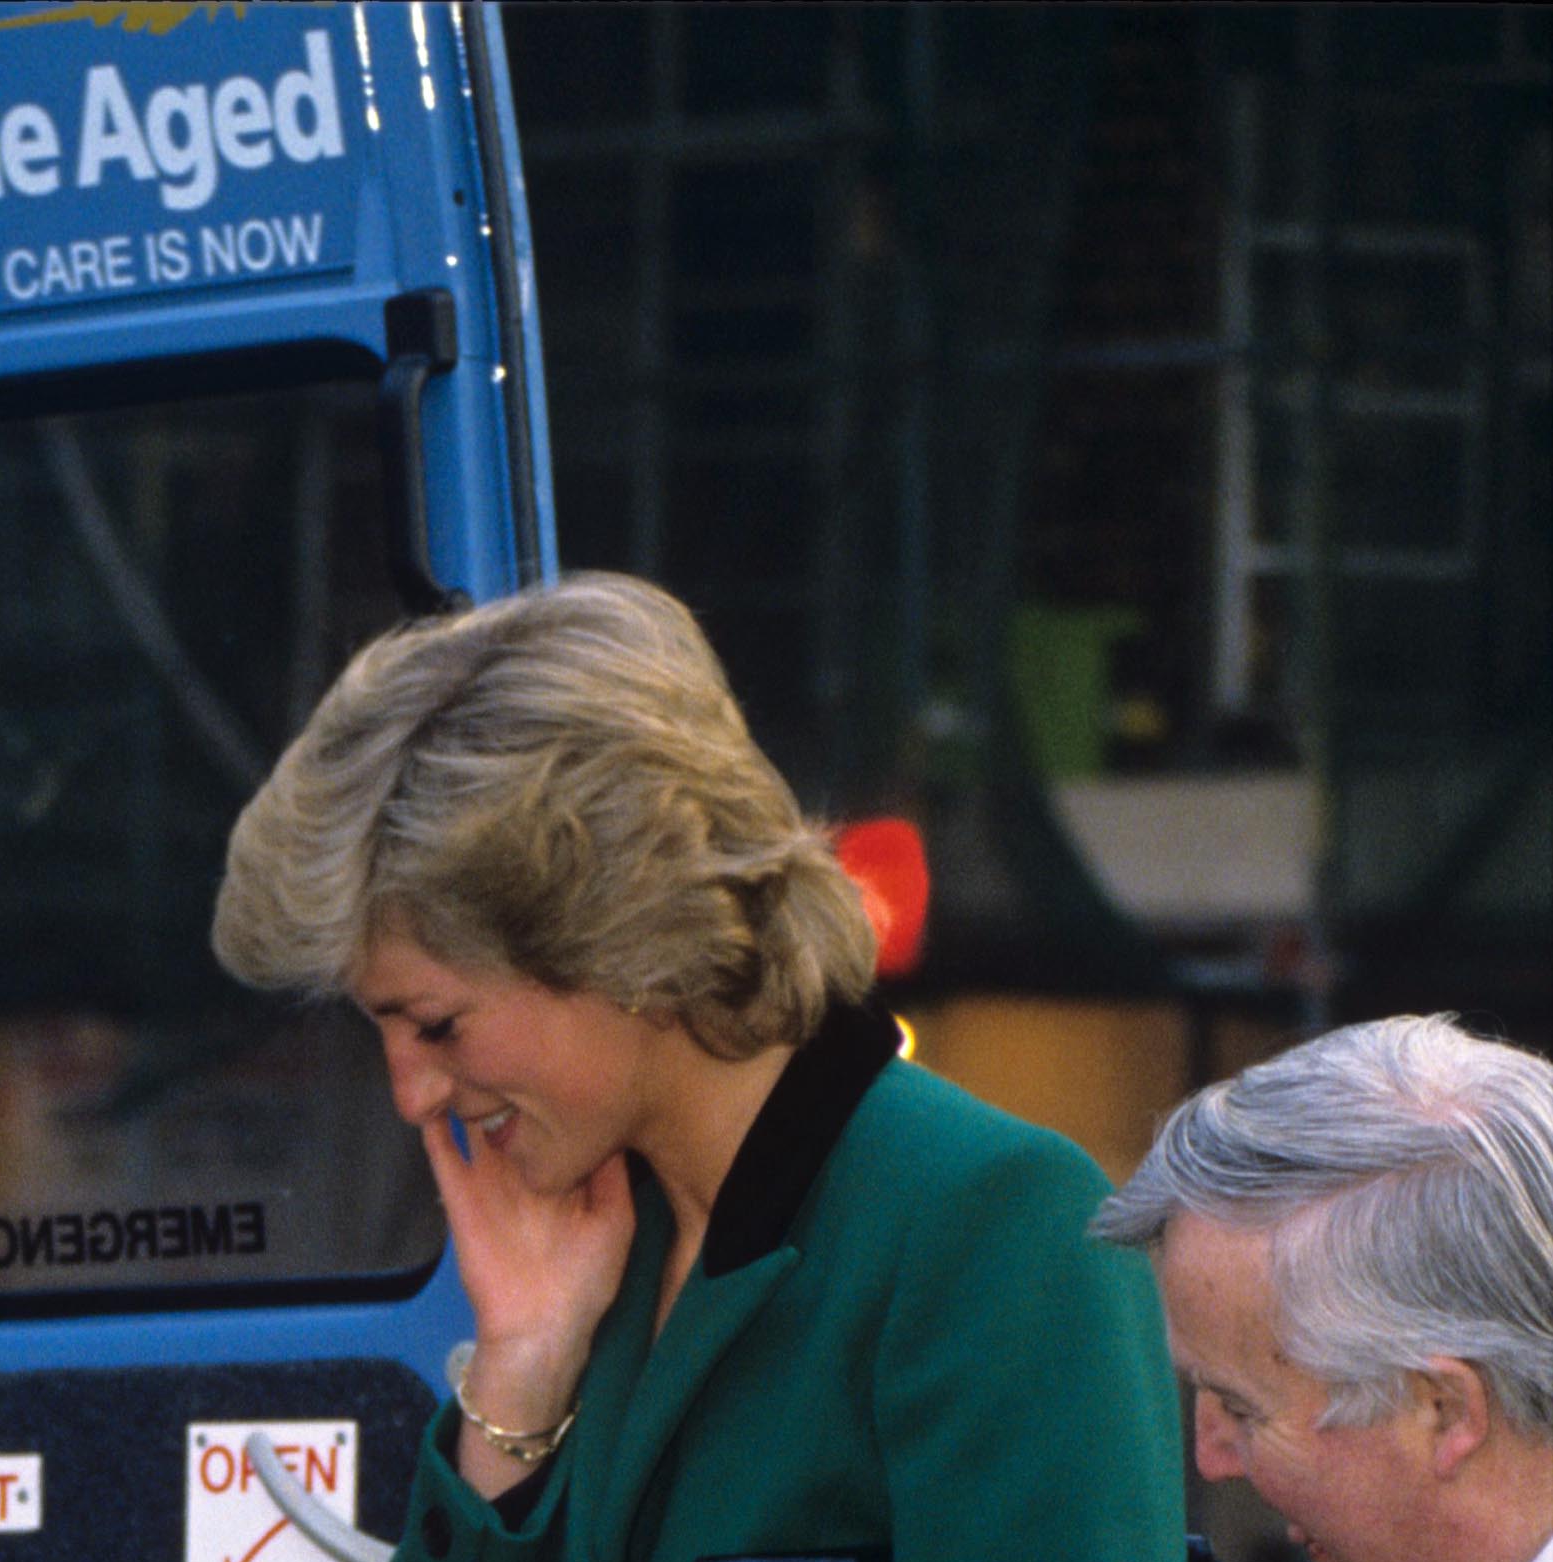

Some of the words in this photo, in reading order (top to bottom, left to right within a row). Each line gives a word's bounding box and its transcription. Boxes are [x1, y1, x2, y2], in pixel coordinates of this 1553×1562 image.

[76, 28, 346, 212] Aged
[4, 235, 135, 300] CARE
[145, 228, 191, 282] IS
[200, 213, 323, 276] NOW
